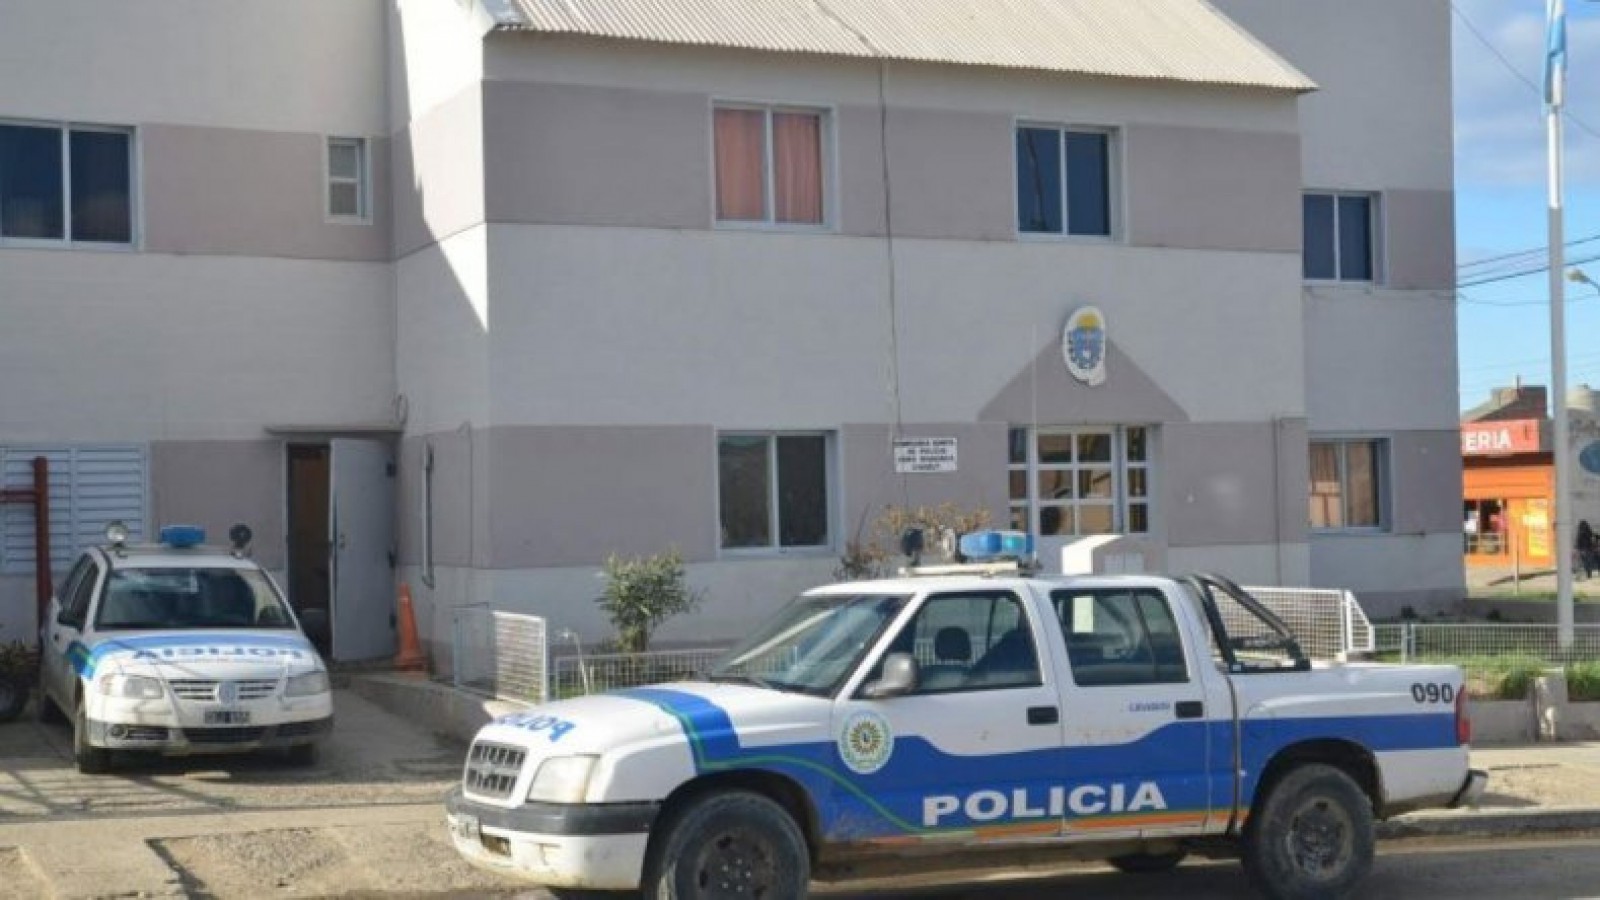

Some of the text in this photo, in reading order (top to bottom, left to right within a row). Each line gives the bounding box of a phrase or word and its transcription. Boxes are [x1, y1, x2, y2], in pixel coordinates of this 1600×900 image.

[1465, 429, 1511, 450] ERIA
[1411, 682, 1453, 704] 090
[922, 781, 1167, 826] POLICIA
